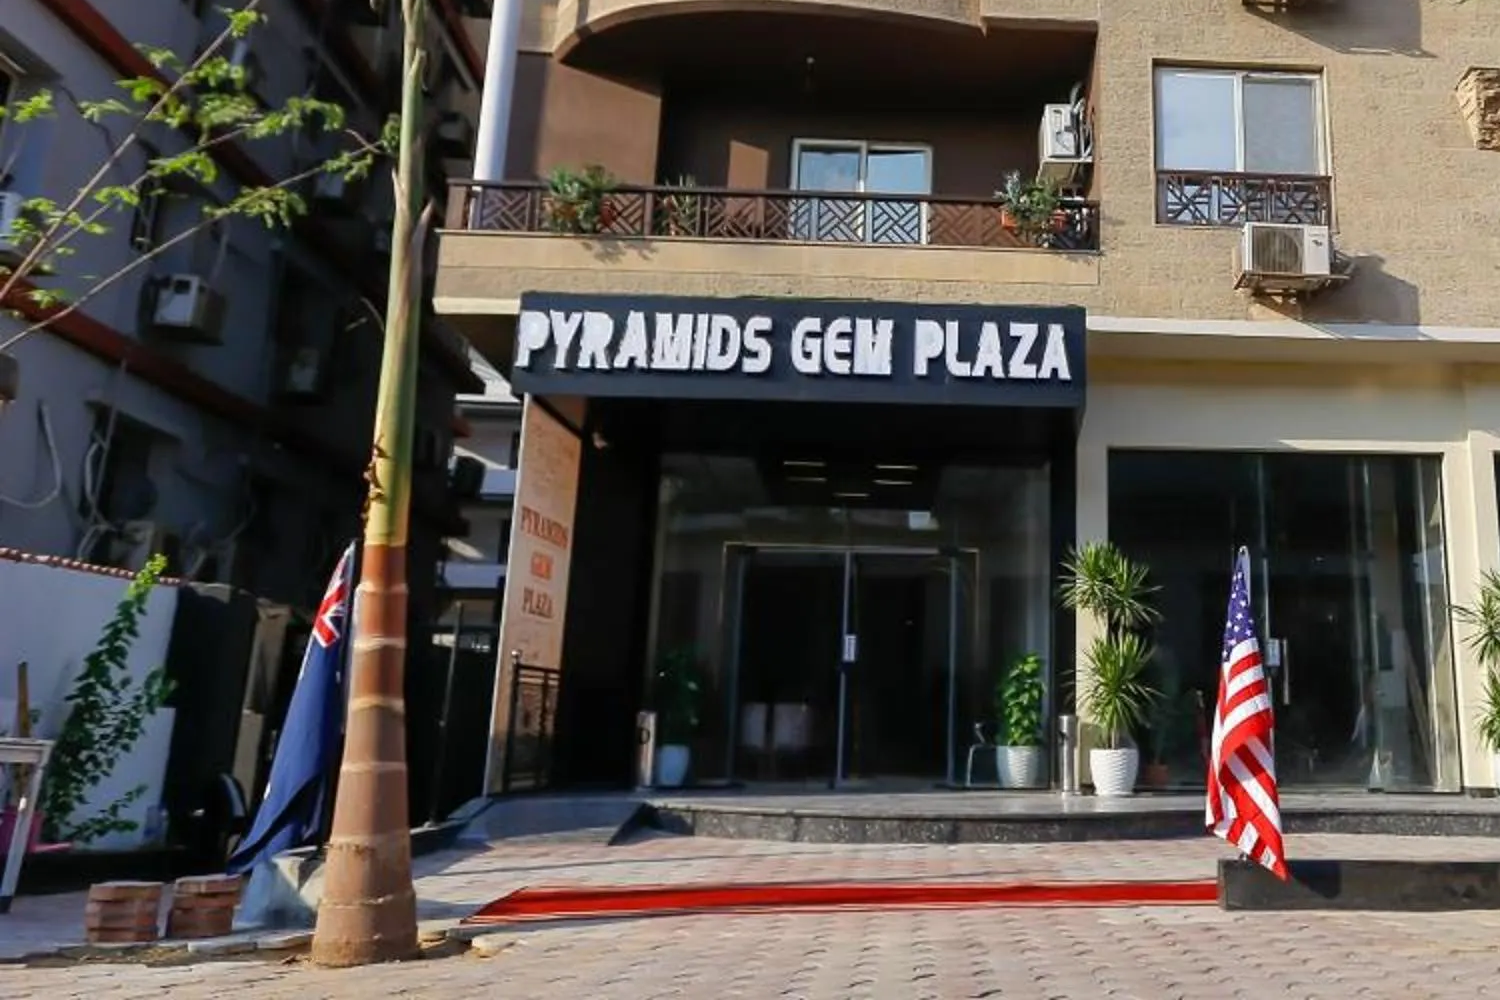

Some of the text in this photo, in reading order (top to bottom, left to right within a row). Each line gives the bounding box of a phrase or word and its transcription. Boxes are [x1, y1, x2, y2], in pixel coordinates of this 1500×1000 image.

[514, 309, 1072, 381] PYRAMIDS GEM PLAZA
